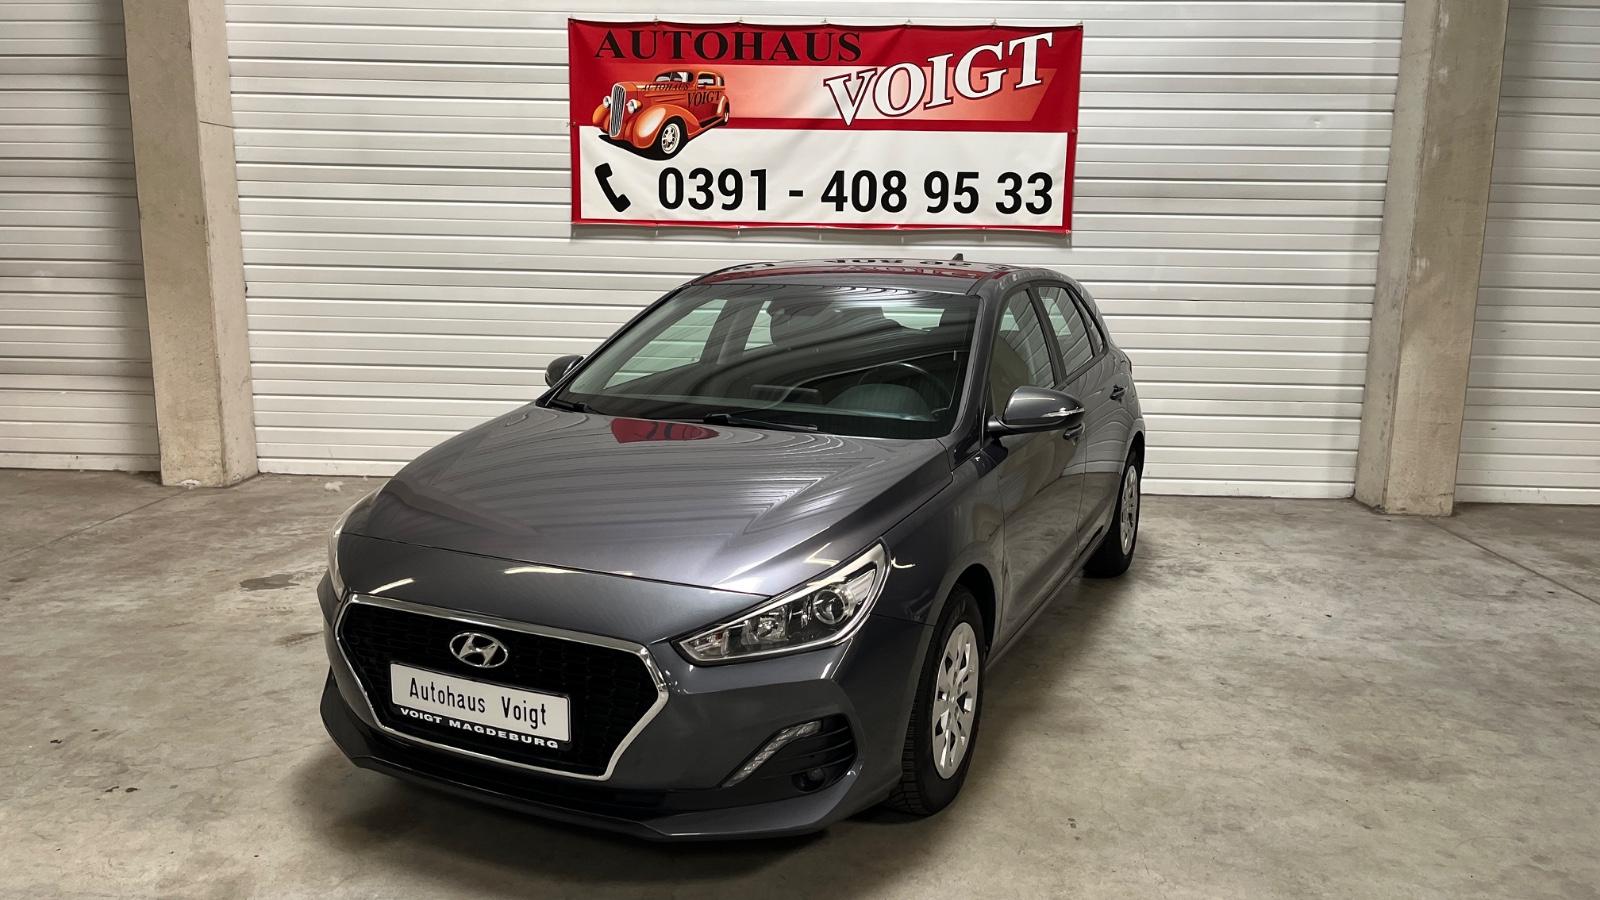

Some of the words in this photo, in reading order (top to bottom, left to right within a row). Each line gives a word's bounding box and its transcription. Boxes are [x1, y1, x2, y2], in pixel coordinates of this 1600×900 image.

[594, 29, 862, 62] AUTOHAUS
[640, 83, 689, 92] AUTOHAUS
[687, 90, 721, 108] VOIGT
[823, 31, 1054, 126] VOIGT
[658, 167, 767, 211] 0391
[788, 189, 804, 197] -
[821, 169, 907, 213] 408
[923, 170, 980, 214] 95
[995, 171, 1053, 214] 33
[409, 677, 485, 713] Autohaus
[501, 696, 547, 730] Voigt
[400, 707, 443, 724] VOIGT
[449, 719, 558, 749] MAGDEBURG
